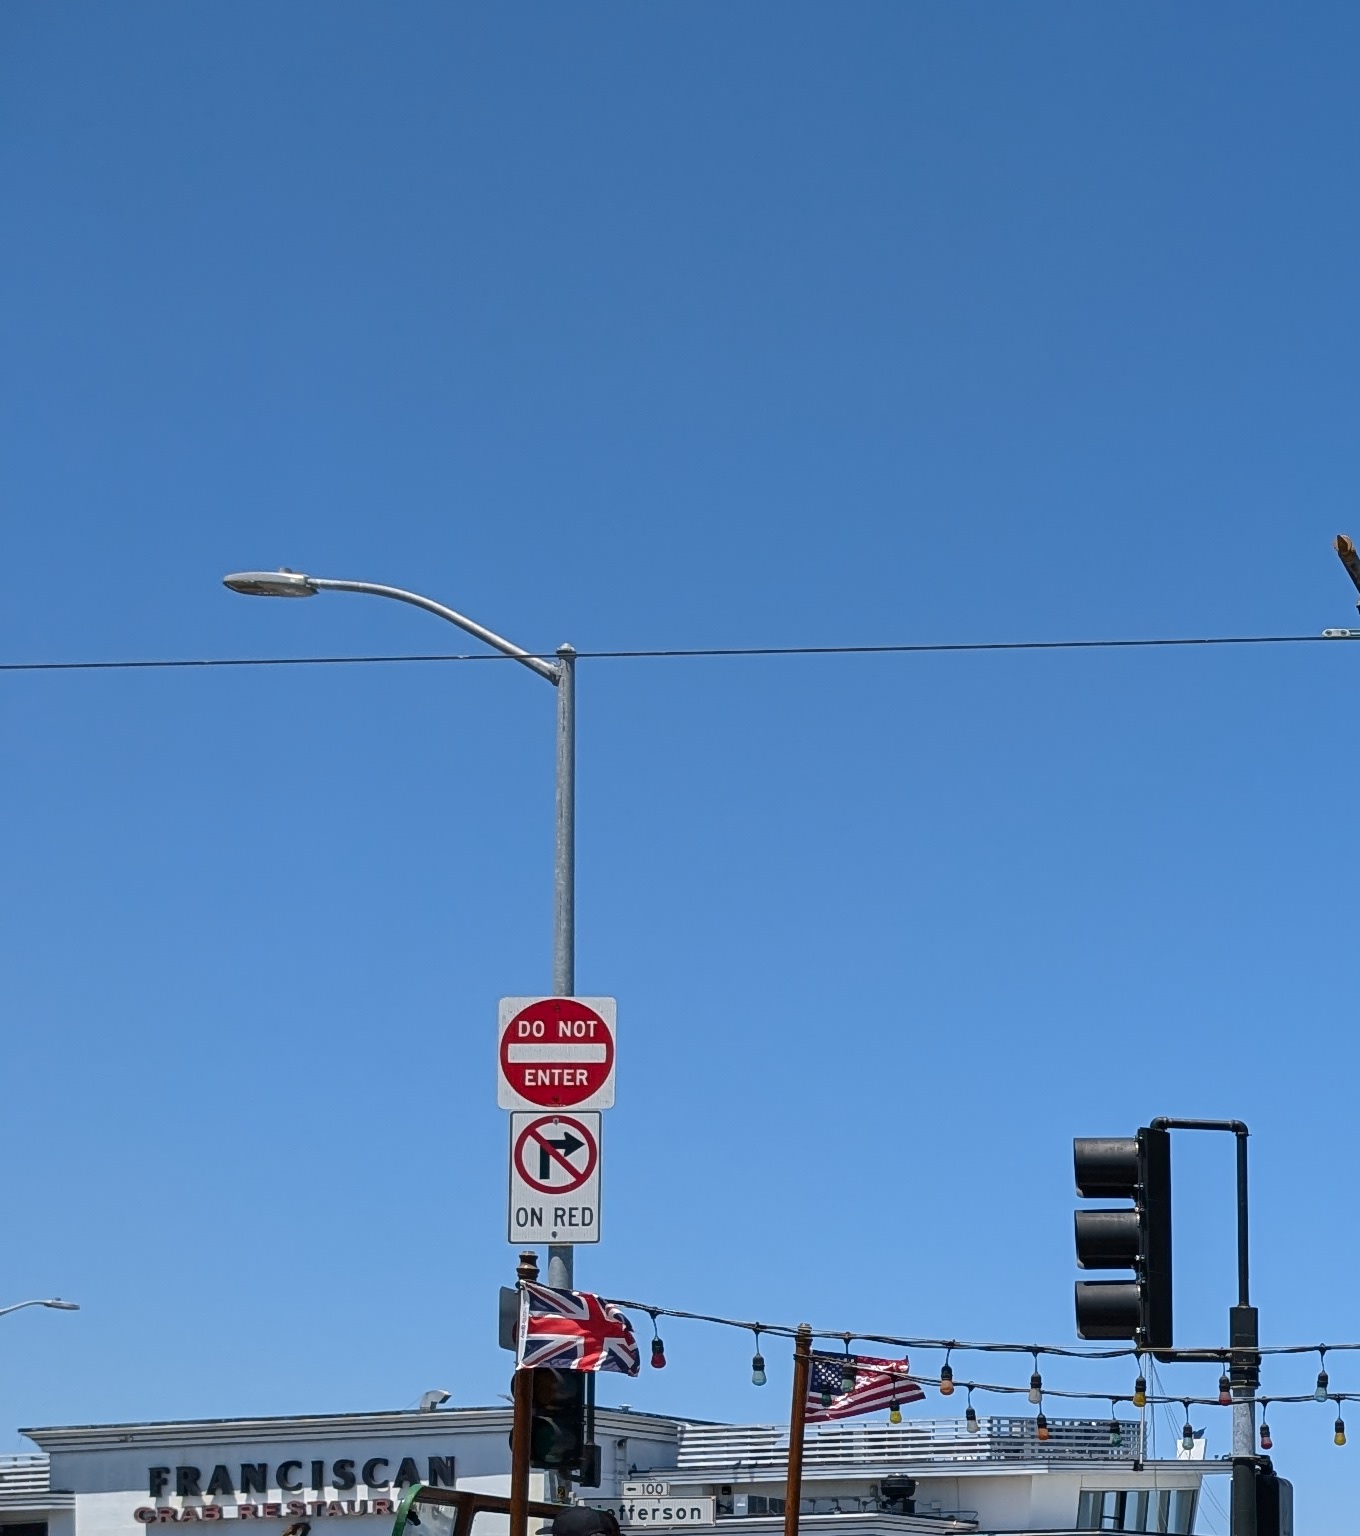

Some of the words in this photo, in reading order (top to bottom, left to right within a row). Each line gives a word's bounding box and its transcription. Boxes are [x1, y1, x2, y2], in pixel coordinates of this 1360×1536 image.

[517, 1020, 545, 1037] DO
[558, 1020, 597, 1037] NOT
[524, 1069, 588, 1086] ENTER
[516, 1207, 543, 1227] ON
[553, 1207, 594, 1227] RED
[148, 1456, 456, 1497] FRANCISCAN
[641, 1483, 663, 1495] 100
[134, 1503, 224, 1523] CRAB
[240, 1498, 394, 1520] RESTAUR
[607, 1504, 701, 1521] fferson
